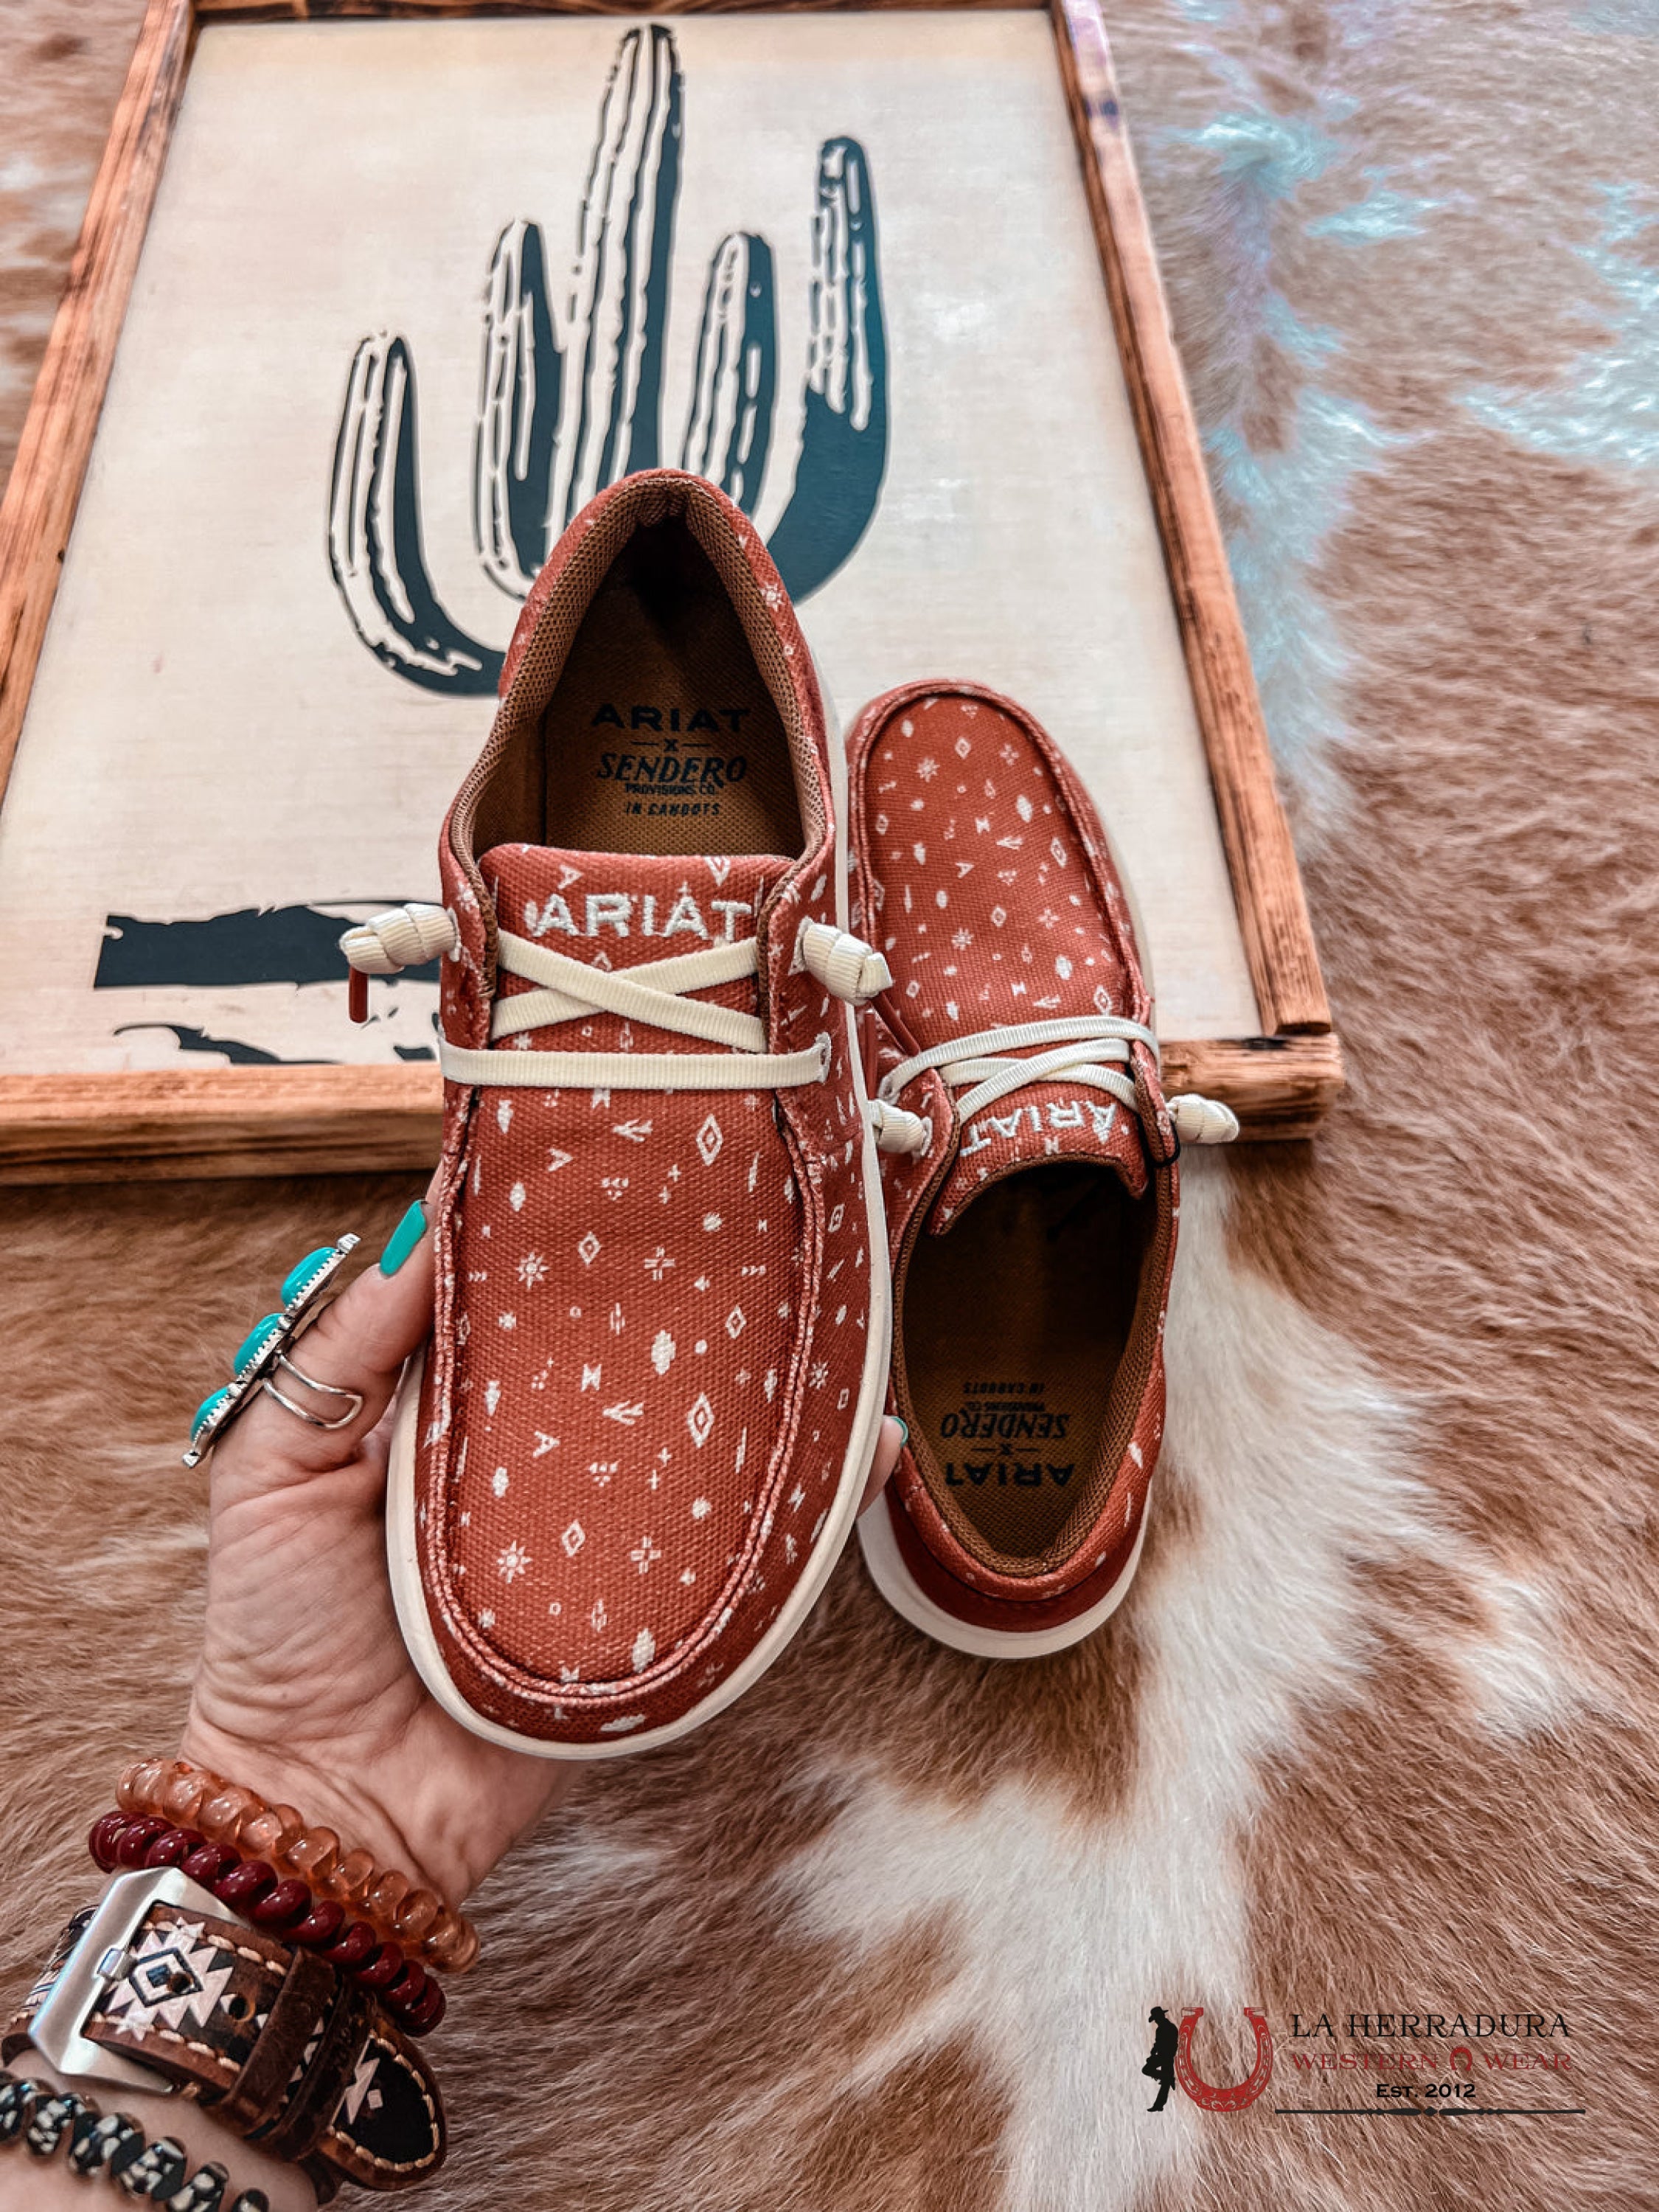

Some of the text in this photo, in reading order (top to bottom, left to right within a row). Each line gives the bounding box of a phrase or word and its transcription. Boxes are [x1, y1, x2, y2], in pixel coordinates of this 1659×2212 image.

[591, 703, 751, 732] ARIAT
[597, 752, 747, 789] SENDERO
[625, 801, 641, 815] IN
[532, 893, 752, 942] ARIAT
[959, 1100, 1117, 1157] ARIAT
[940, 1408, 1069, 1439] SENDERO
[945, 1462, 1075, 1487] ARIAT
